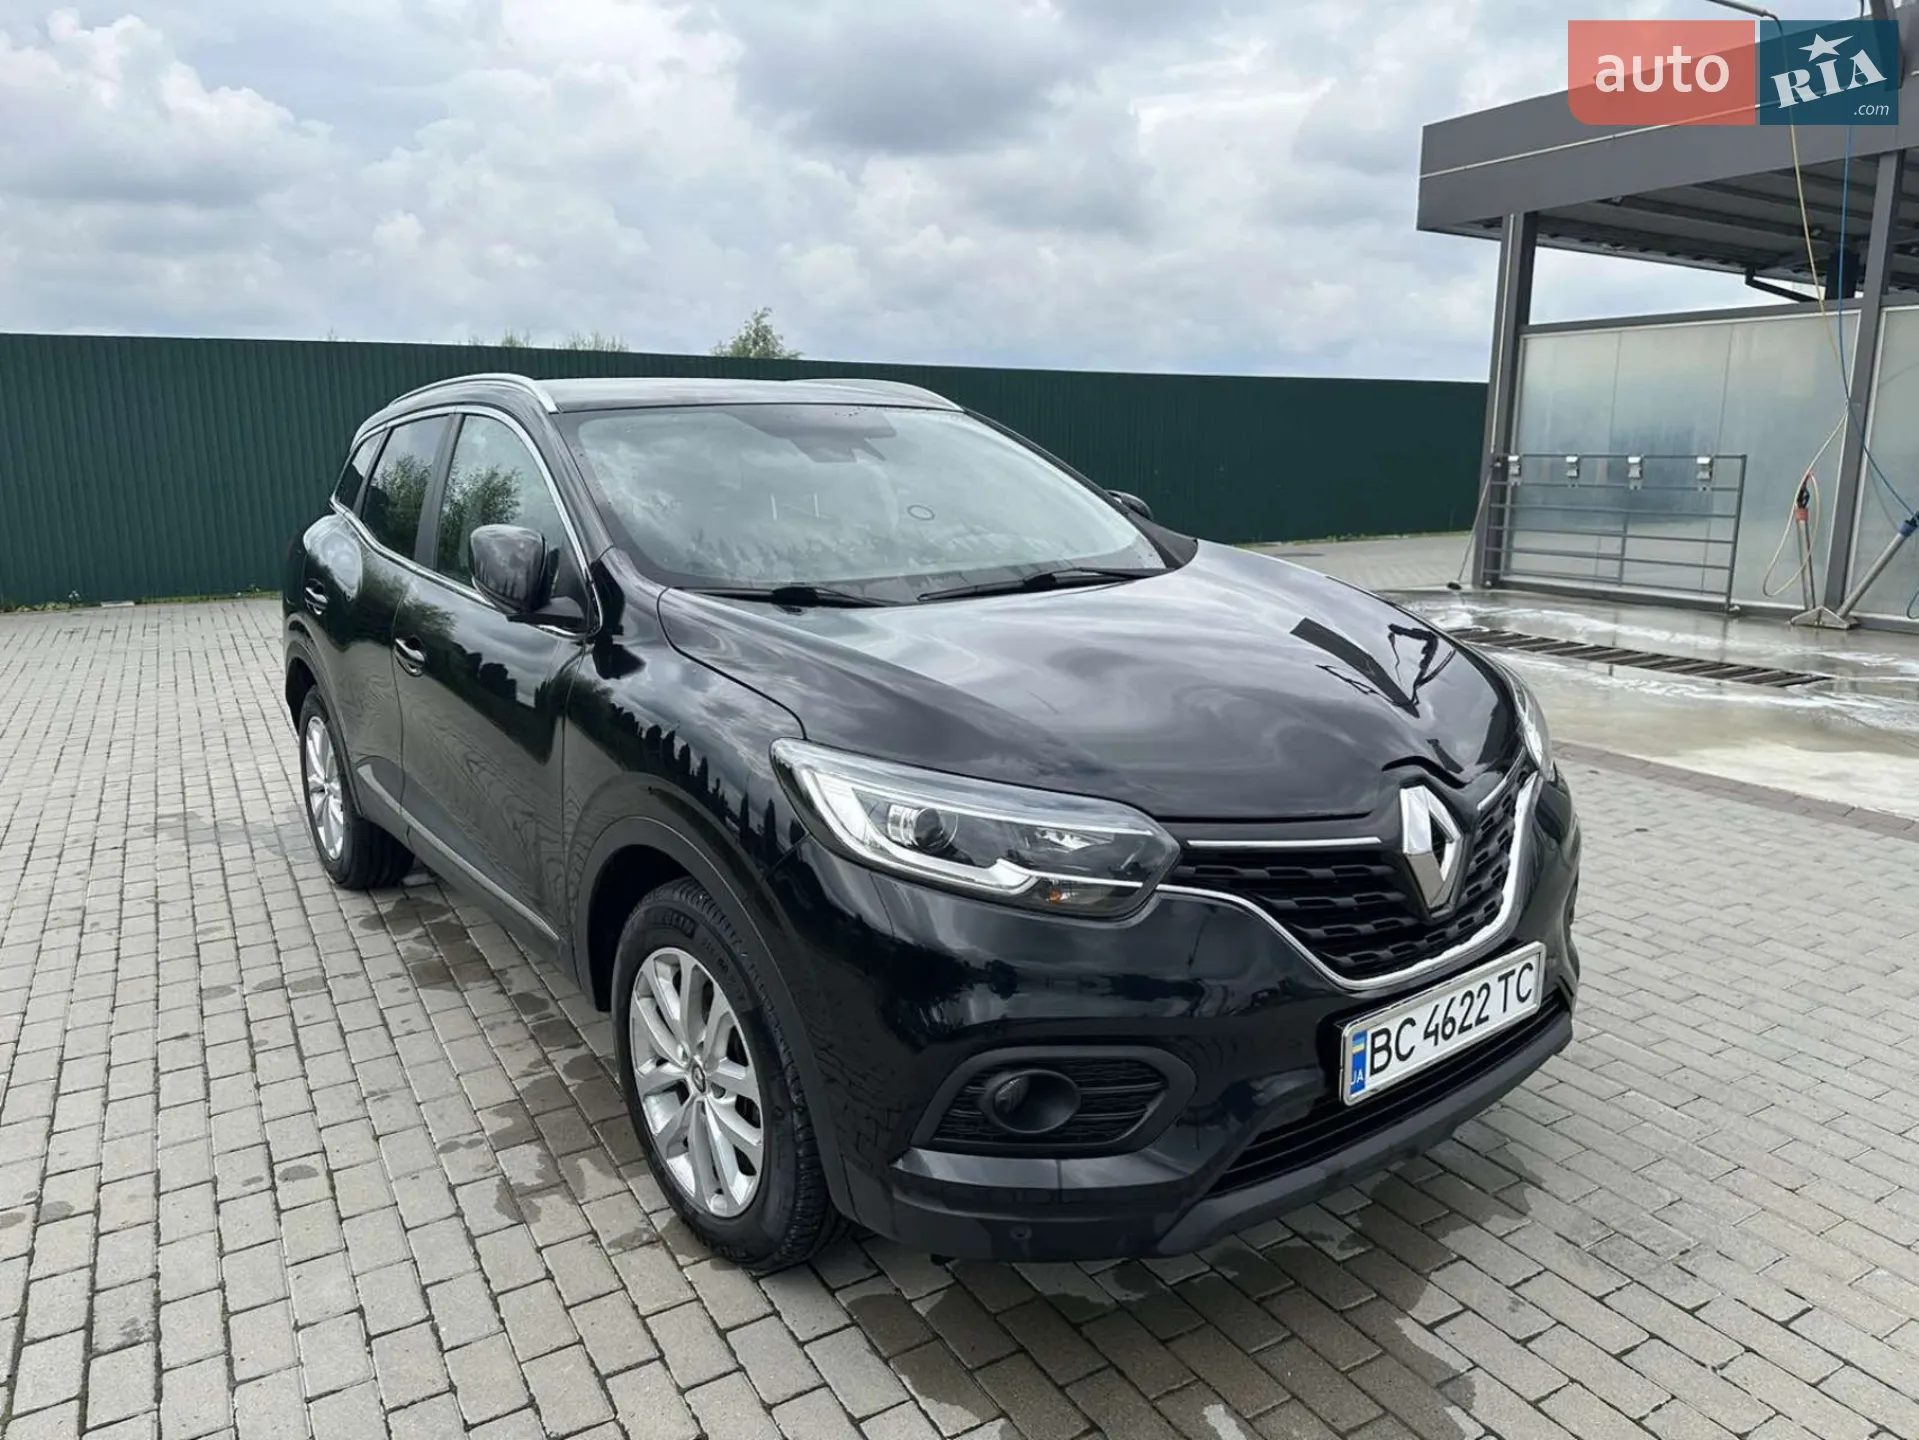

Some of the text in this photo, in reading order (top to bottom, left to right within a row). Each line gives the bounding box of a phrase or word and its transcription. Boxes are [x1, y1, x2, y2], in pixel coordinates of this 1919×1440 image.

[1369, 962, 1533, 1076] BC 4622 TC
